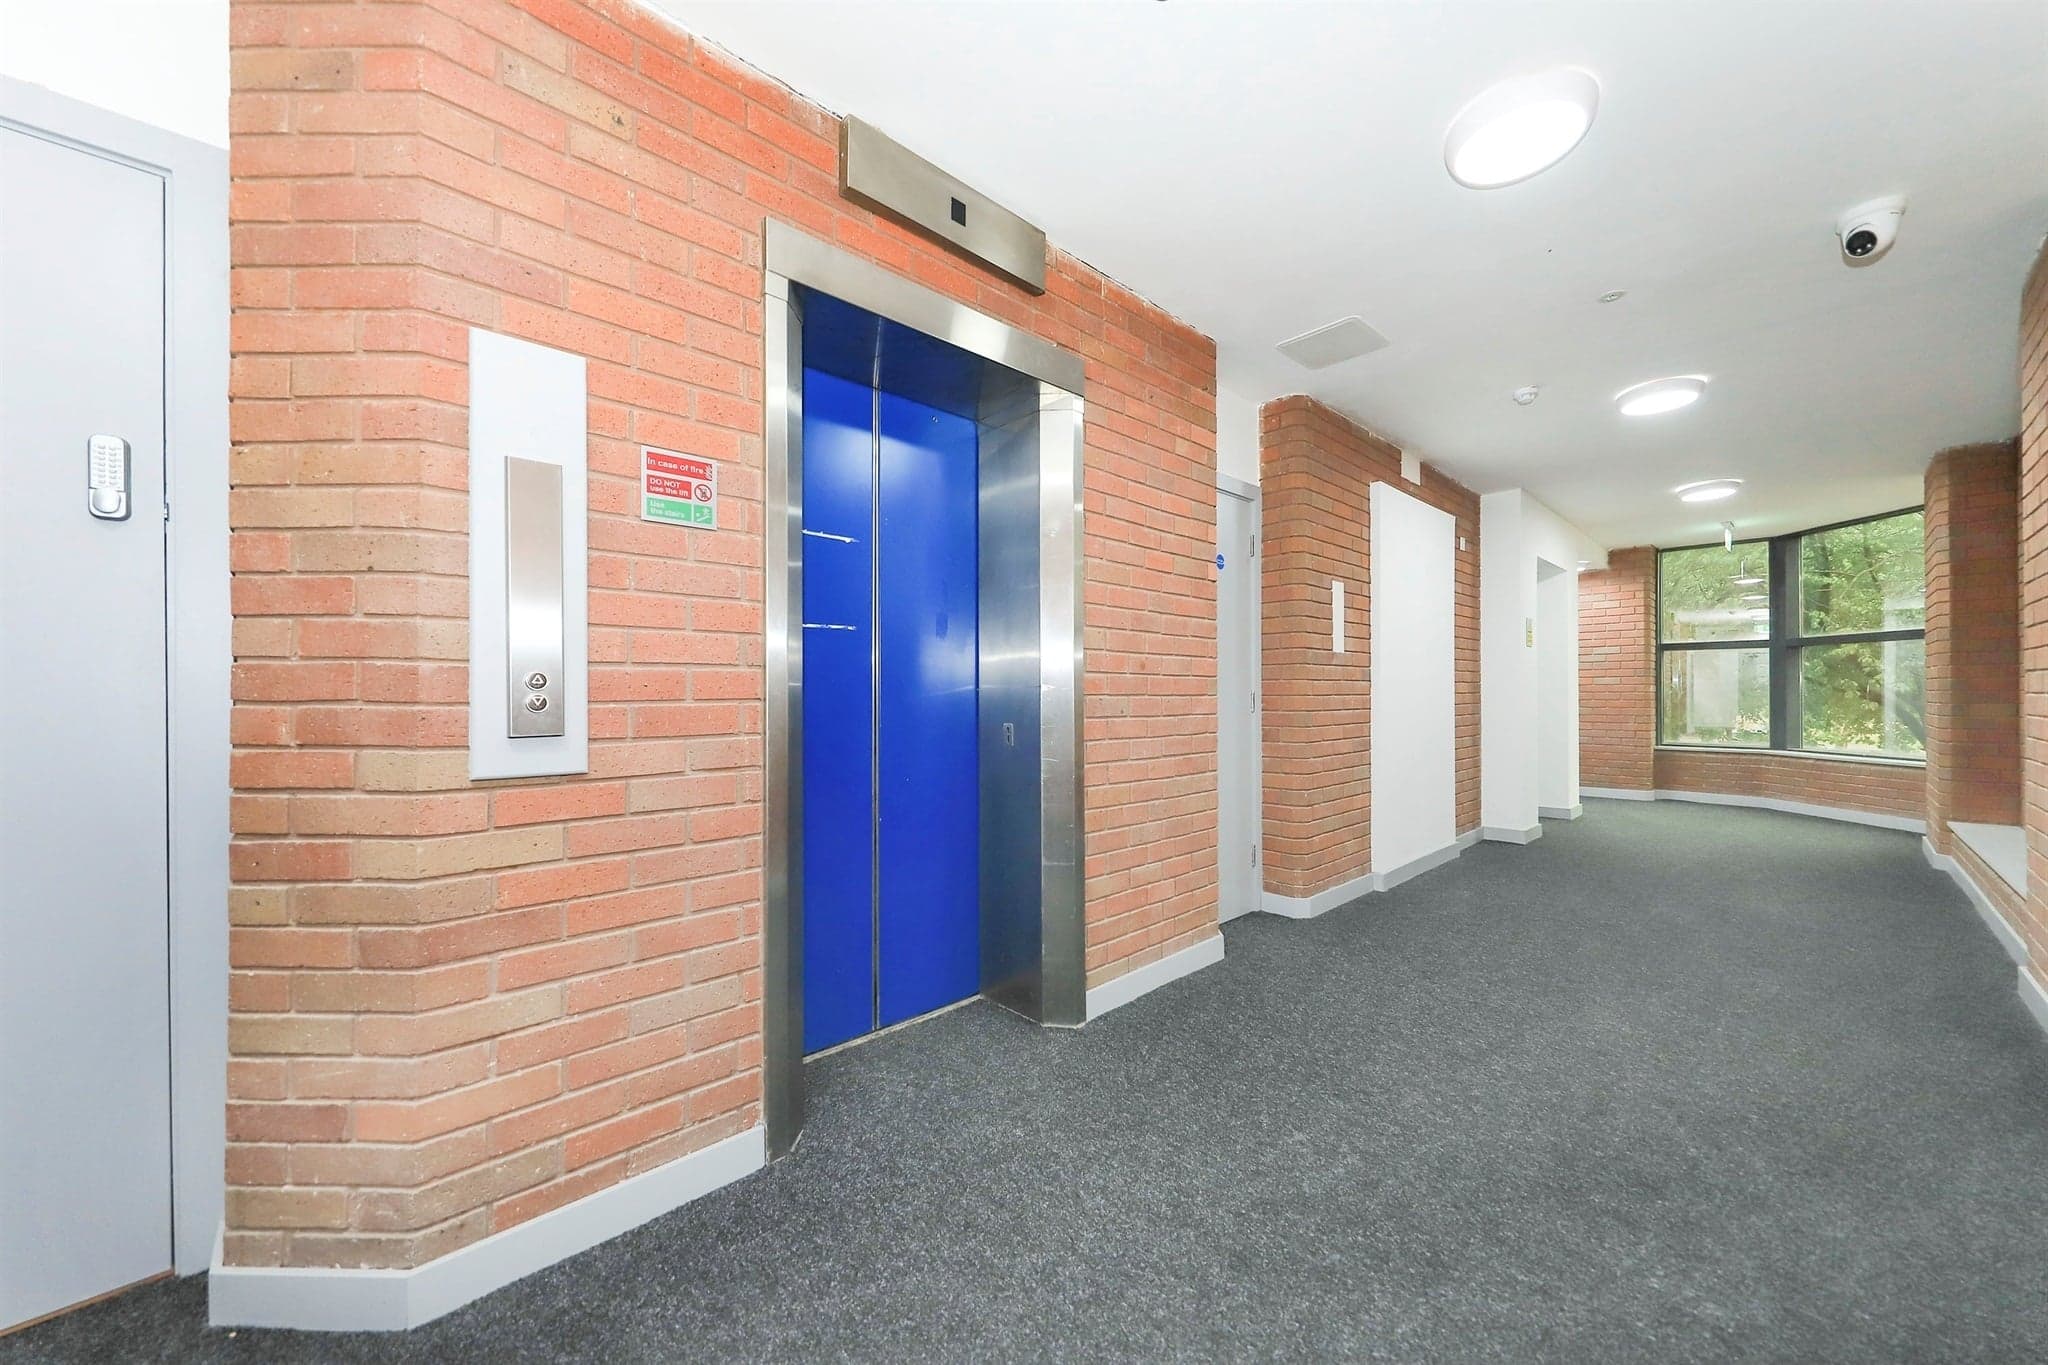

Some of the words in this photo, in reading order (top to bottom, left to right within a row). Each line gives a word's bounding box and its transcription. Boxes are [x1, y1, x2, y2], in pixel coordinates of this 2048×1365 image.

[648, 457, 656, 465] In
[658, 461, 677, 469] case
[691, 466, 704, 474] fire
